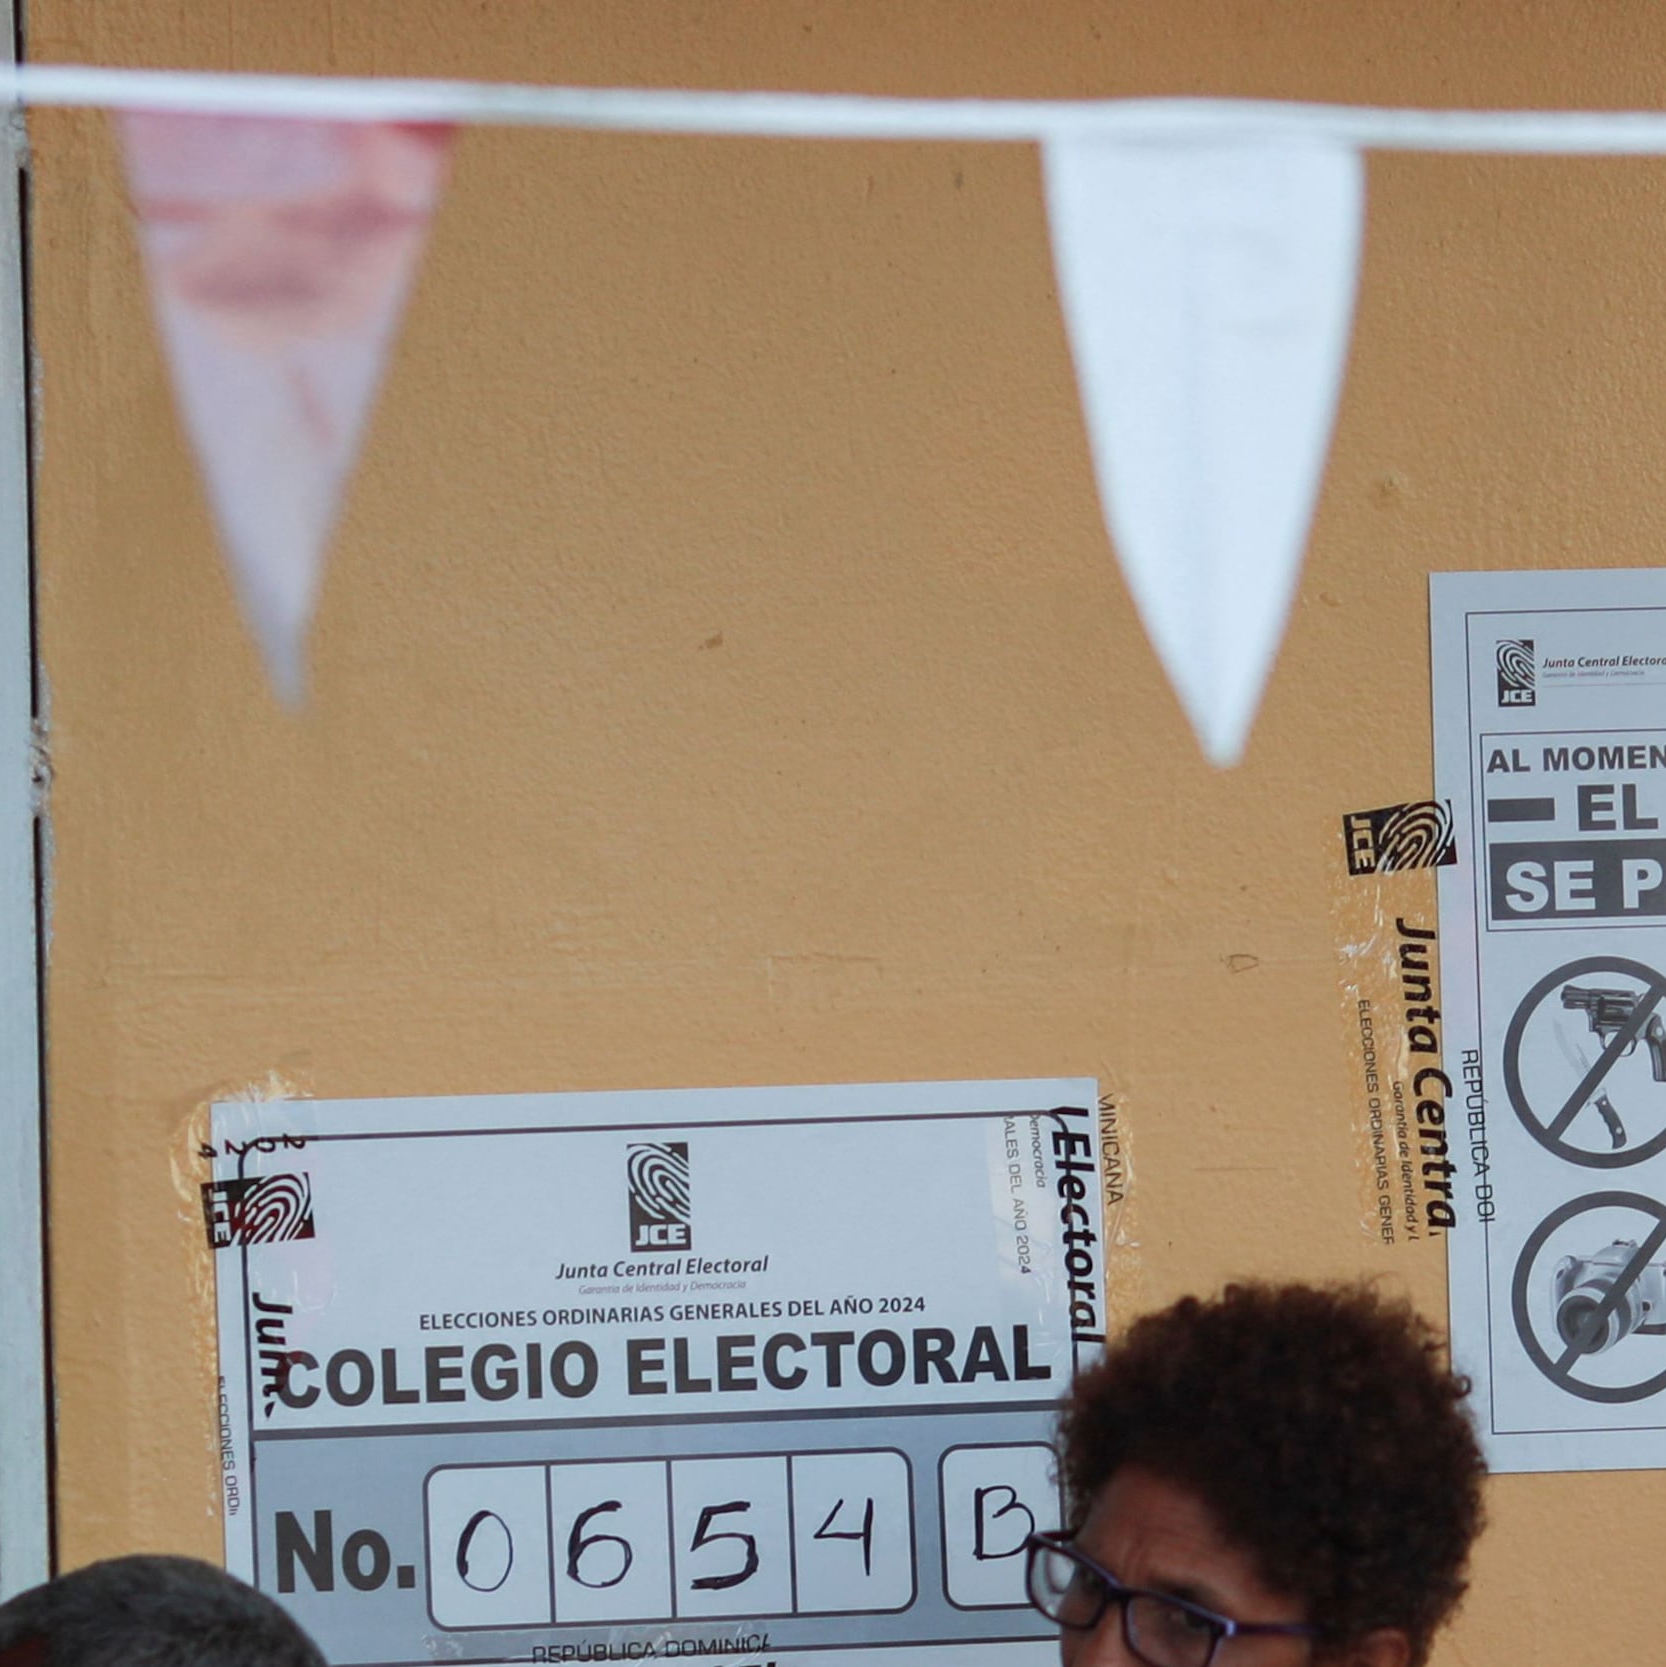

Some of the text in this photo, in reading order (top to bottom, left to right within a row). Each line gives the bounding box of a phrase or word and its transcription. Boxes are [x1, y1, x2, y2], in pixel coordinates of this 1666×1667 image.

[1542, 656, 1575, 669] Junta
[1577, 655, 1621, 668] Central
[1501, 689, 1534, 705] JCE
[1486, 749, 1532, 773] AL
[1577, 781, 1661, 833] EL
[1504, 858, 1596, 914] SE
[1395, 917, 1441, 1053] Junta
[1358, 998, 1380, 1094] ELECCIONES
[1461, 1047, 1490, 1182] REPÚBLICA
[1368, 1094, 1390, 1192] ORDINARIAS
[1008, 1162, 1023, 1193] DEL
[634, 1224, 688, 1247] JCE
[1012, 1198, 1029, 1232] AÑO
[1051, 1130, 1107, 1342] Electoral
[555, 1255, 770, 1281] Junta Central Electoral
[1016, 1233, 1033, 1275] 2024
[419, 1294, 927, 1332] ELECCIONES ORDINARIAS GENERALES DEL AÑO 2024
[276, 1323, 1053, 1410] COLEGIO ELECTORAL
[274, 1508, 417, 1594] No.
[532, 1639, 658, 1664] REPÚBLICA
